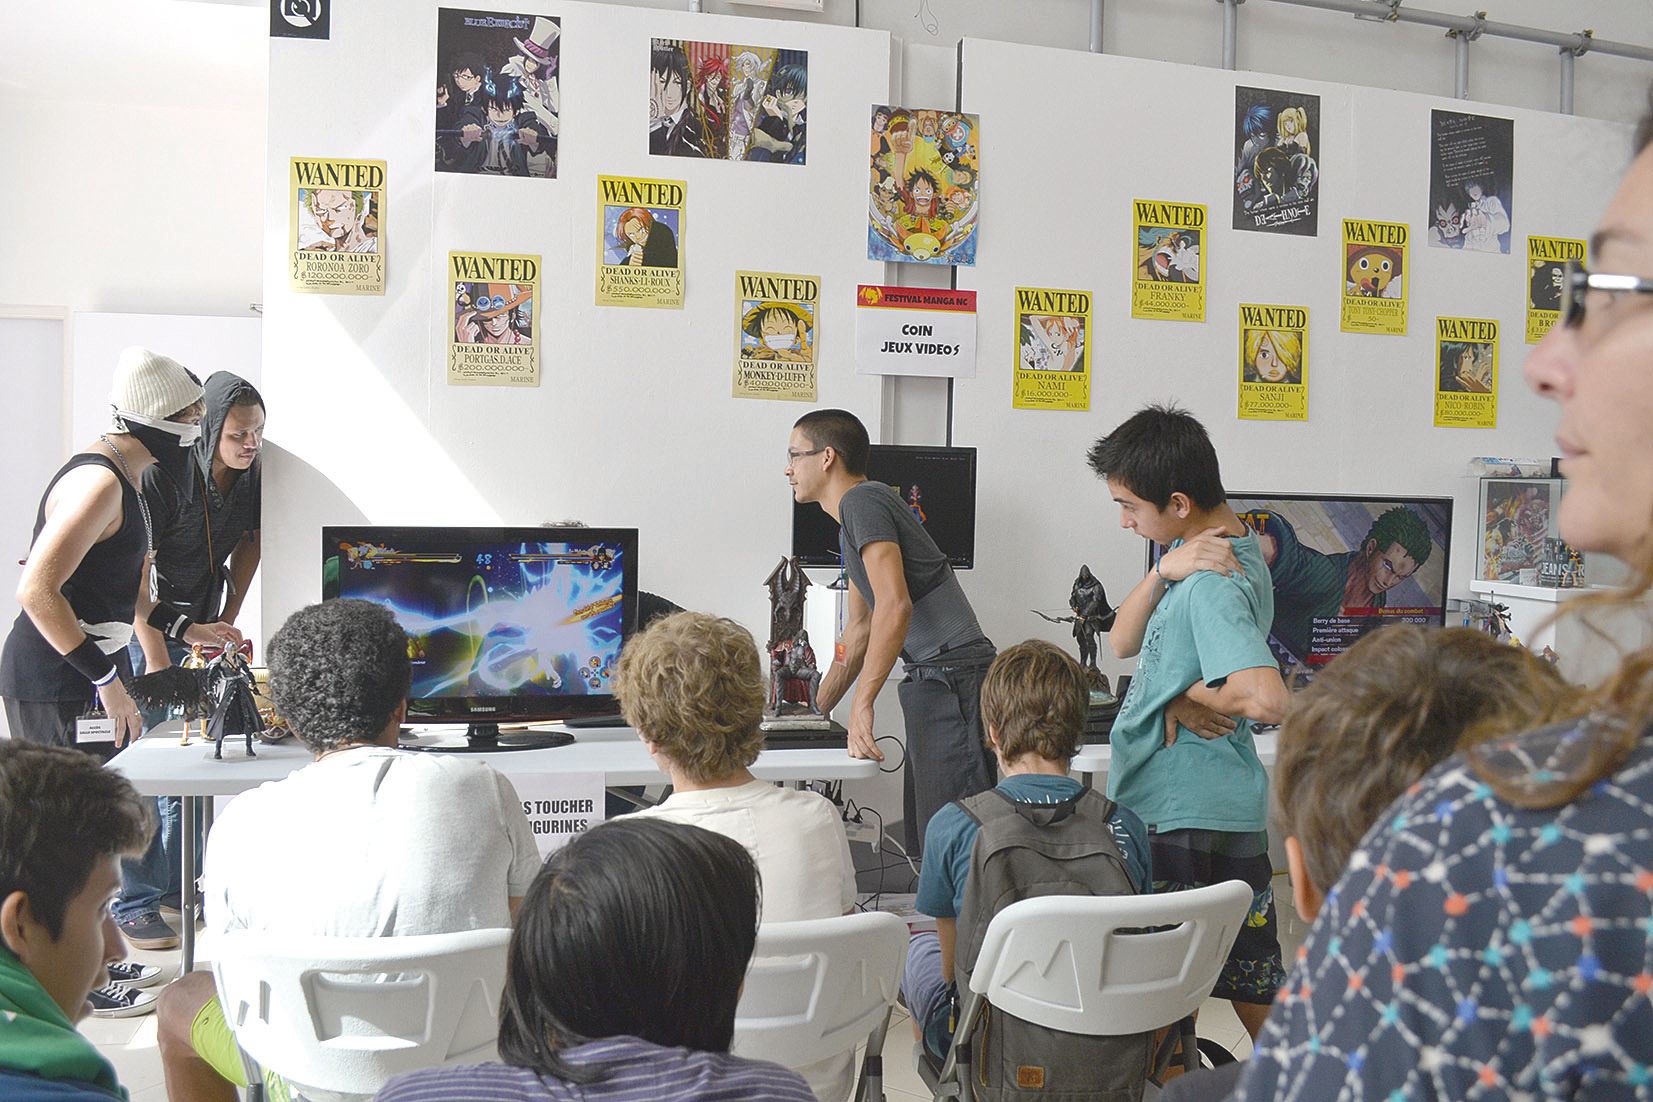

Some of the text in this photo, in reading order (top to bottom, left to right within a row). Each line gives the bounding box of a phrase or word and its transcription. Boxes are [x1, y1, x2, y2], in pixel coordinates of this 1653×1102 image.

[295, 162, 383, 187] WANTED
[602, 180, 682, 205] WANTED
[1136, 203, 1204, 226] WANTED
[1345, 222, 1406, 244] WANTED
[1529, 239, 1584, 260] WANTED
[306, 262, 369, 273] RORONOA ZORO
[453, 256, 536, 280] WANTED
[634, 268, 647, 276] OR
[648, 270, 676, 278] ALIVE
[740, 276, 817, 300] WANTED
[884, 294, 968, 306] FESTIVAL MANGA NC
[1018, 290, 1089, 313] WANTED
[1150, 292, 1186, 301] FRANKY
[1242, 307, 1306, 328] WANTED
[902, 324, 933, 336] COIN
[1439, 320, 1496, 340] WANTED
[881, 342, 960, 356] JEUX VIDEOS
[1038, 381, 1065, 390] NAMI
[1260, 393, 1284, 401] SANJI
[1444, 401, 1485, 410] NICO ROBIN
[476, 554, 492, 565] 48
[1541, 562, 1569, 576] JEANS
[534, 800, 593, 814] TOUCHER
